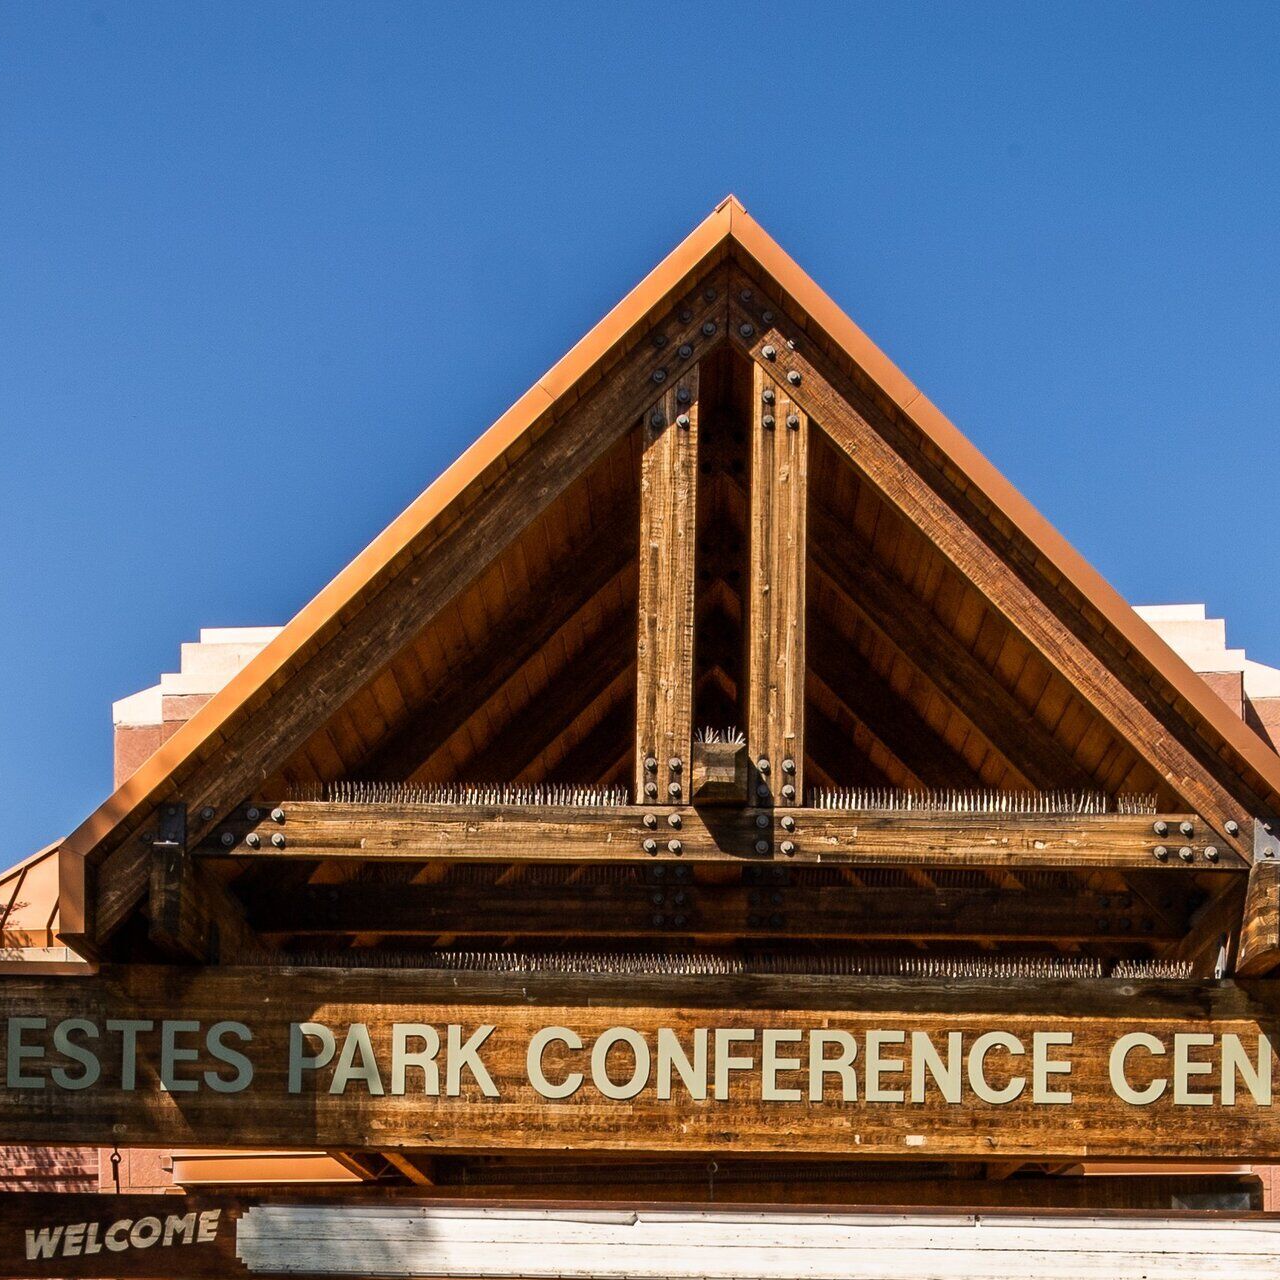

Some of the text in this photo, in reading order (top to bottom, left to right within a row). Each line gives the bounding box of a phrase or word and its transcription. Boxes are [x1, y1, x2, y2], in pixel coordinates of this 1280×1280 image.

[6, 1017, 254, 1093] ESTES
[288, 1022, 500, 1097] PARK
[527, 1027, 1073, 1104] CONFERENCE
[25, 1208, 222, 1261] WELCOME
